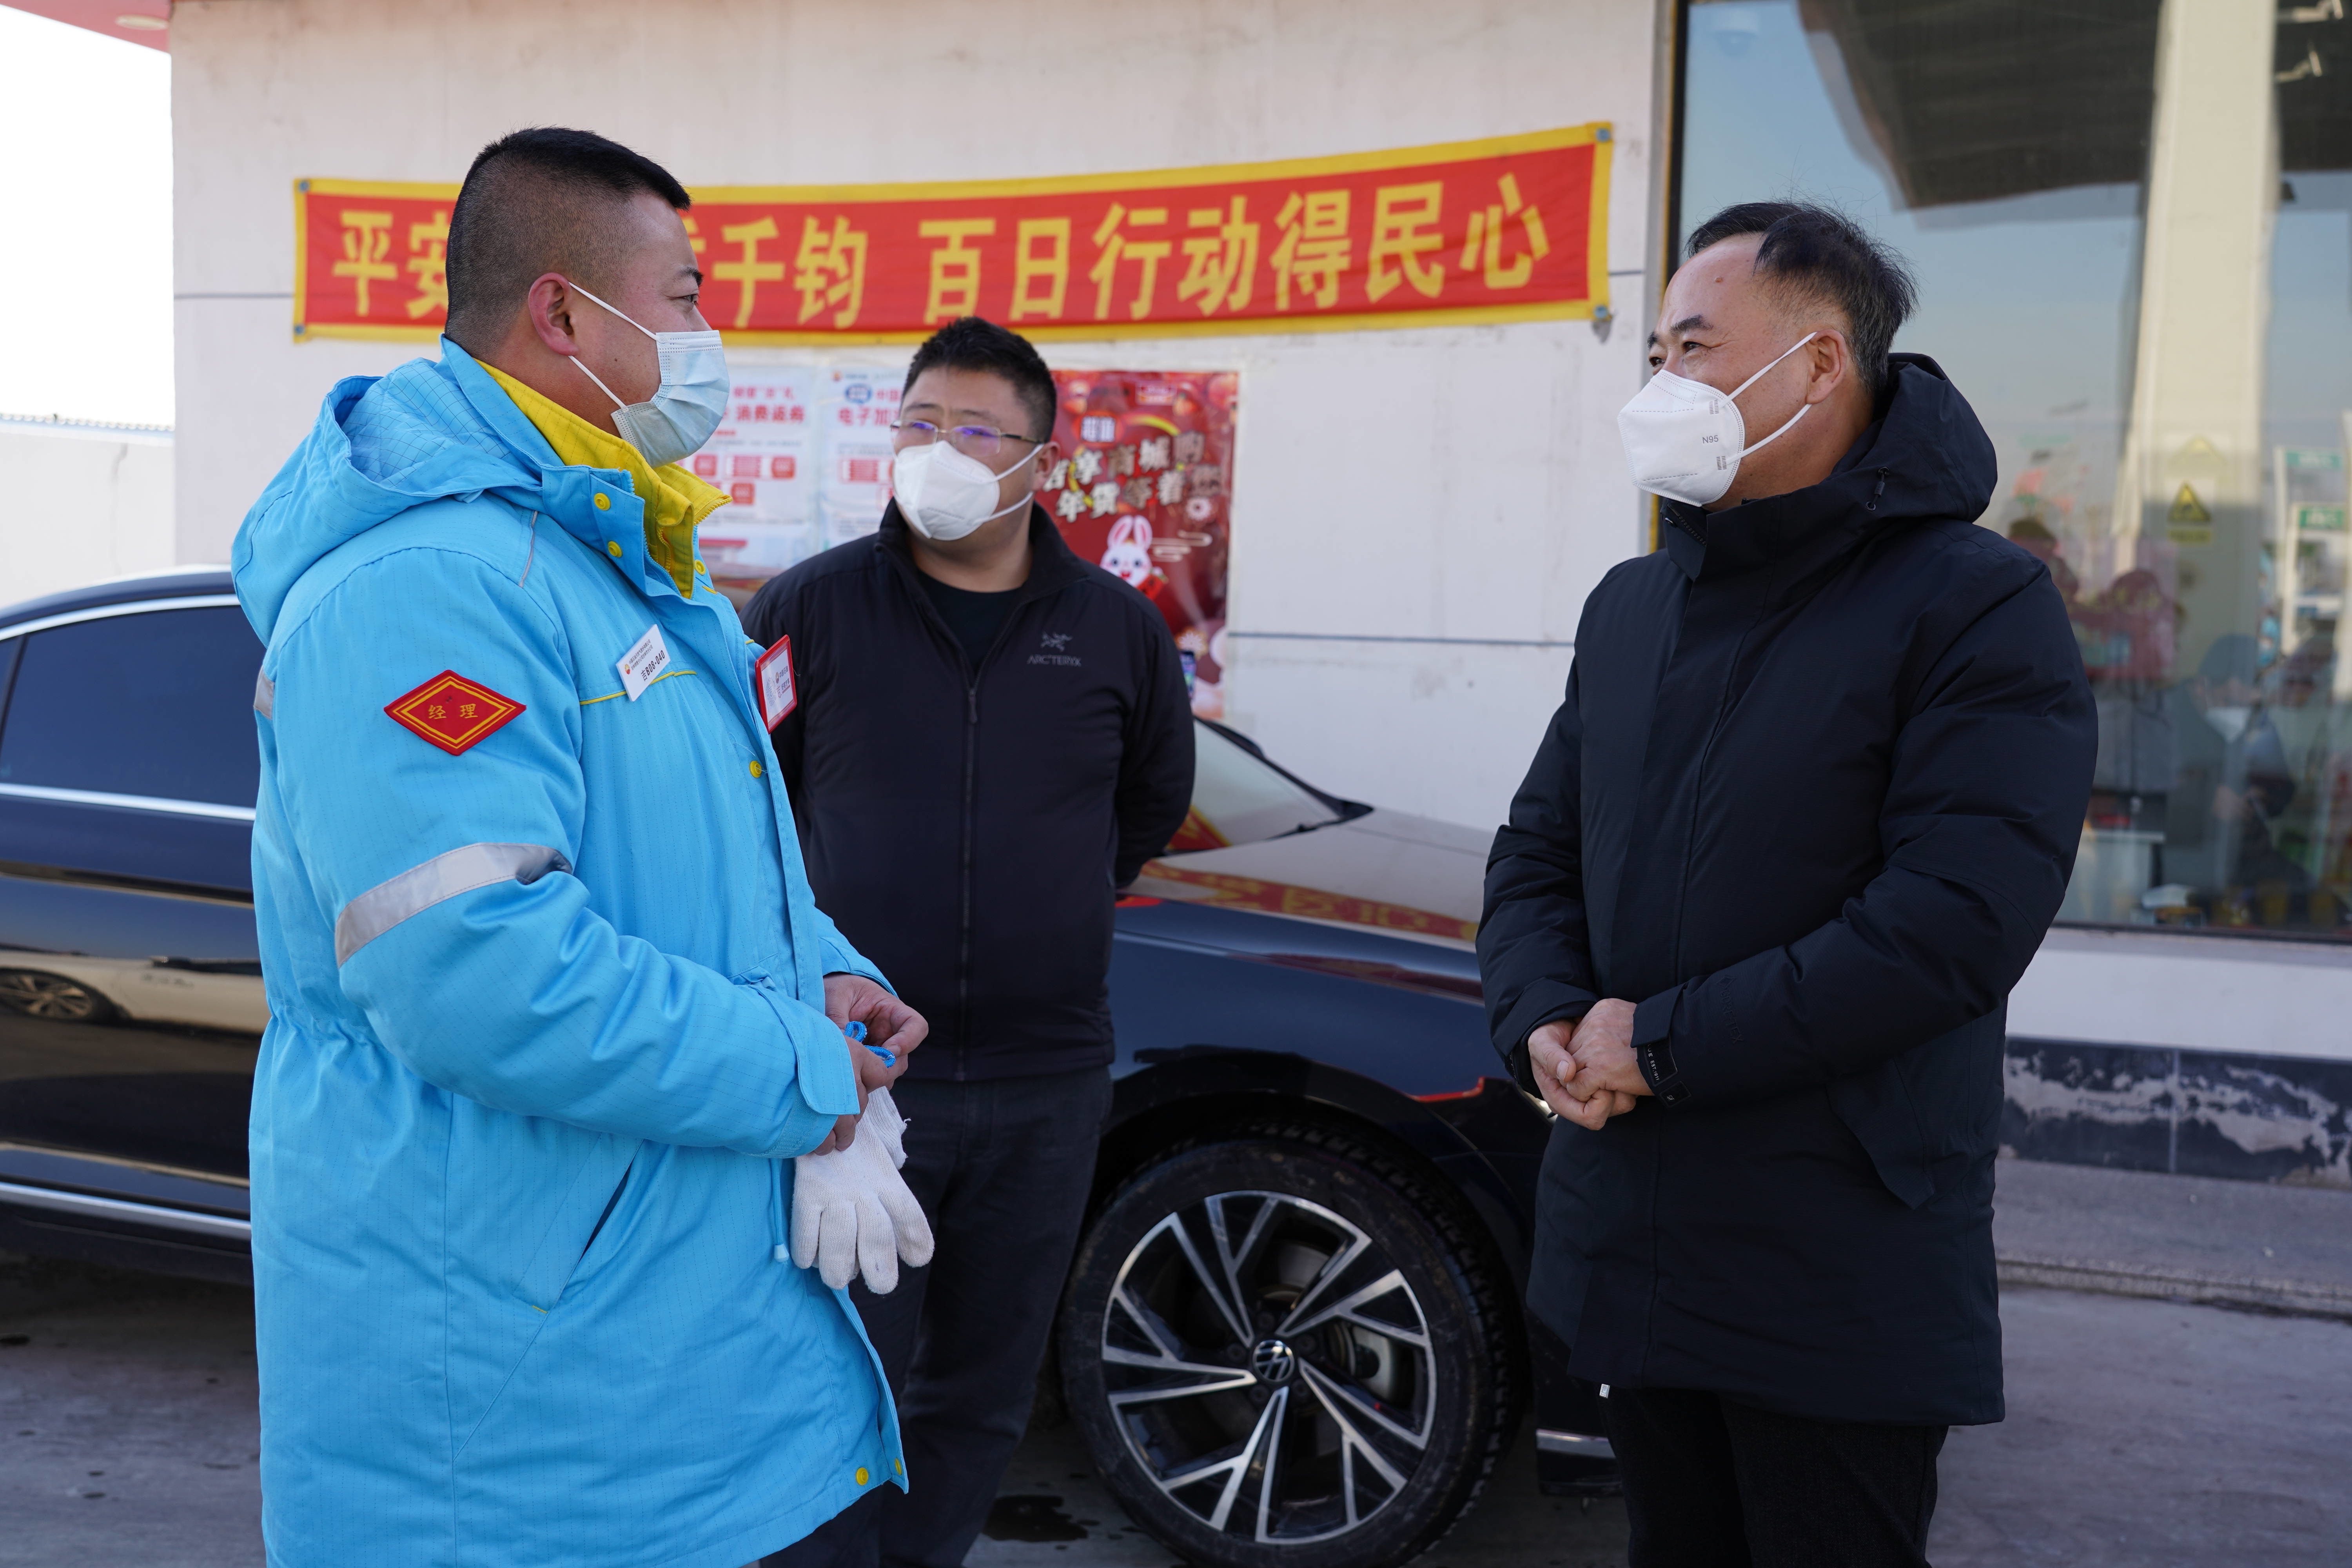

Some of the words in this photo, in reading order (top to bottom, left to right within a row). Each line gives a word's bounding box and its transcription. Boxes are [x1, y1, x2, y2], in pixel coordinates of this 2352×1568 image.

[332, 210, 869, 329] 平安千钧
[918, 172, 1550, 325] 百日行动得民心
[838, 406, 898, 426] 电子加
[1702, 435, 1719, 444] N95
[428, 703, 479, 719] 经理
